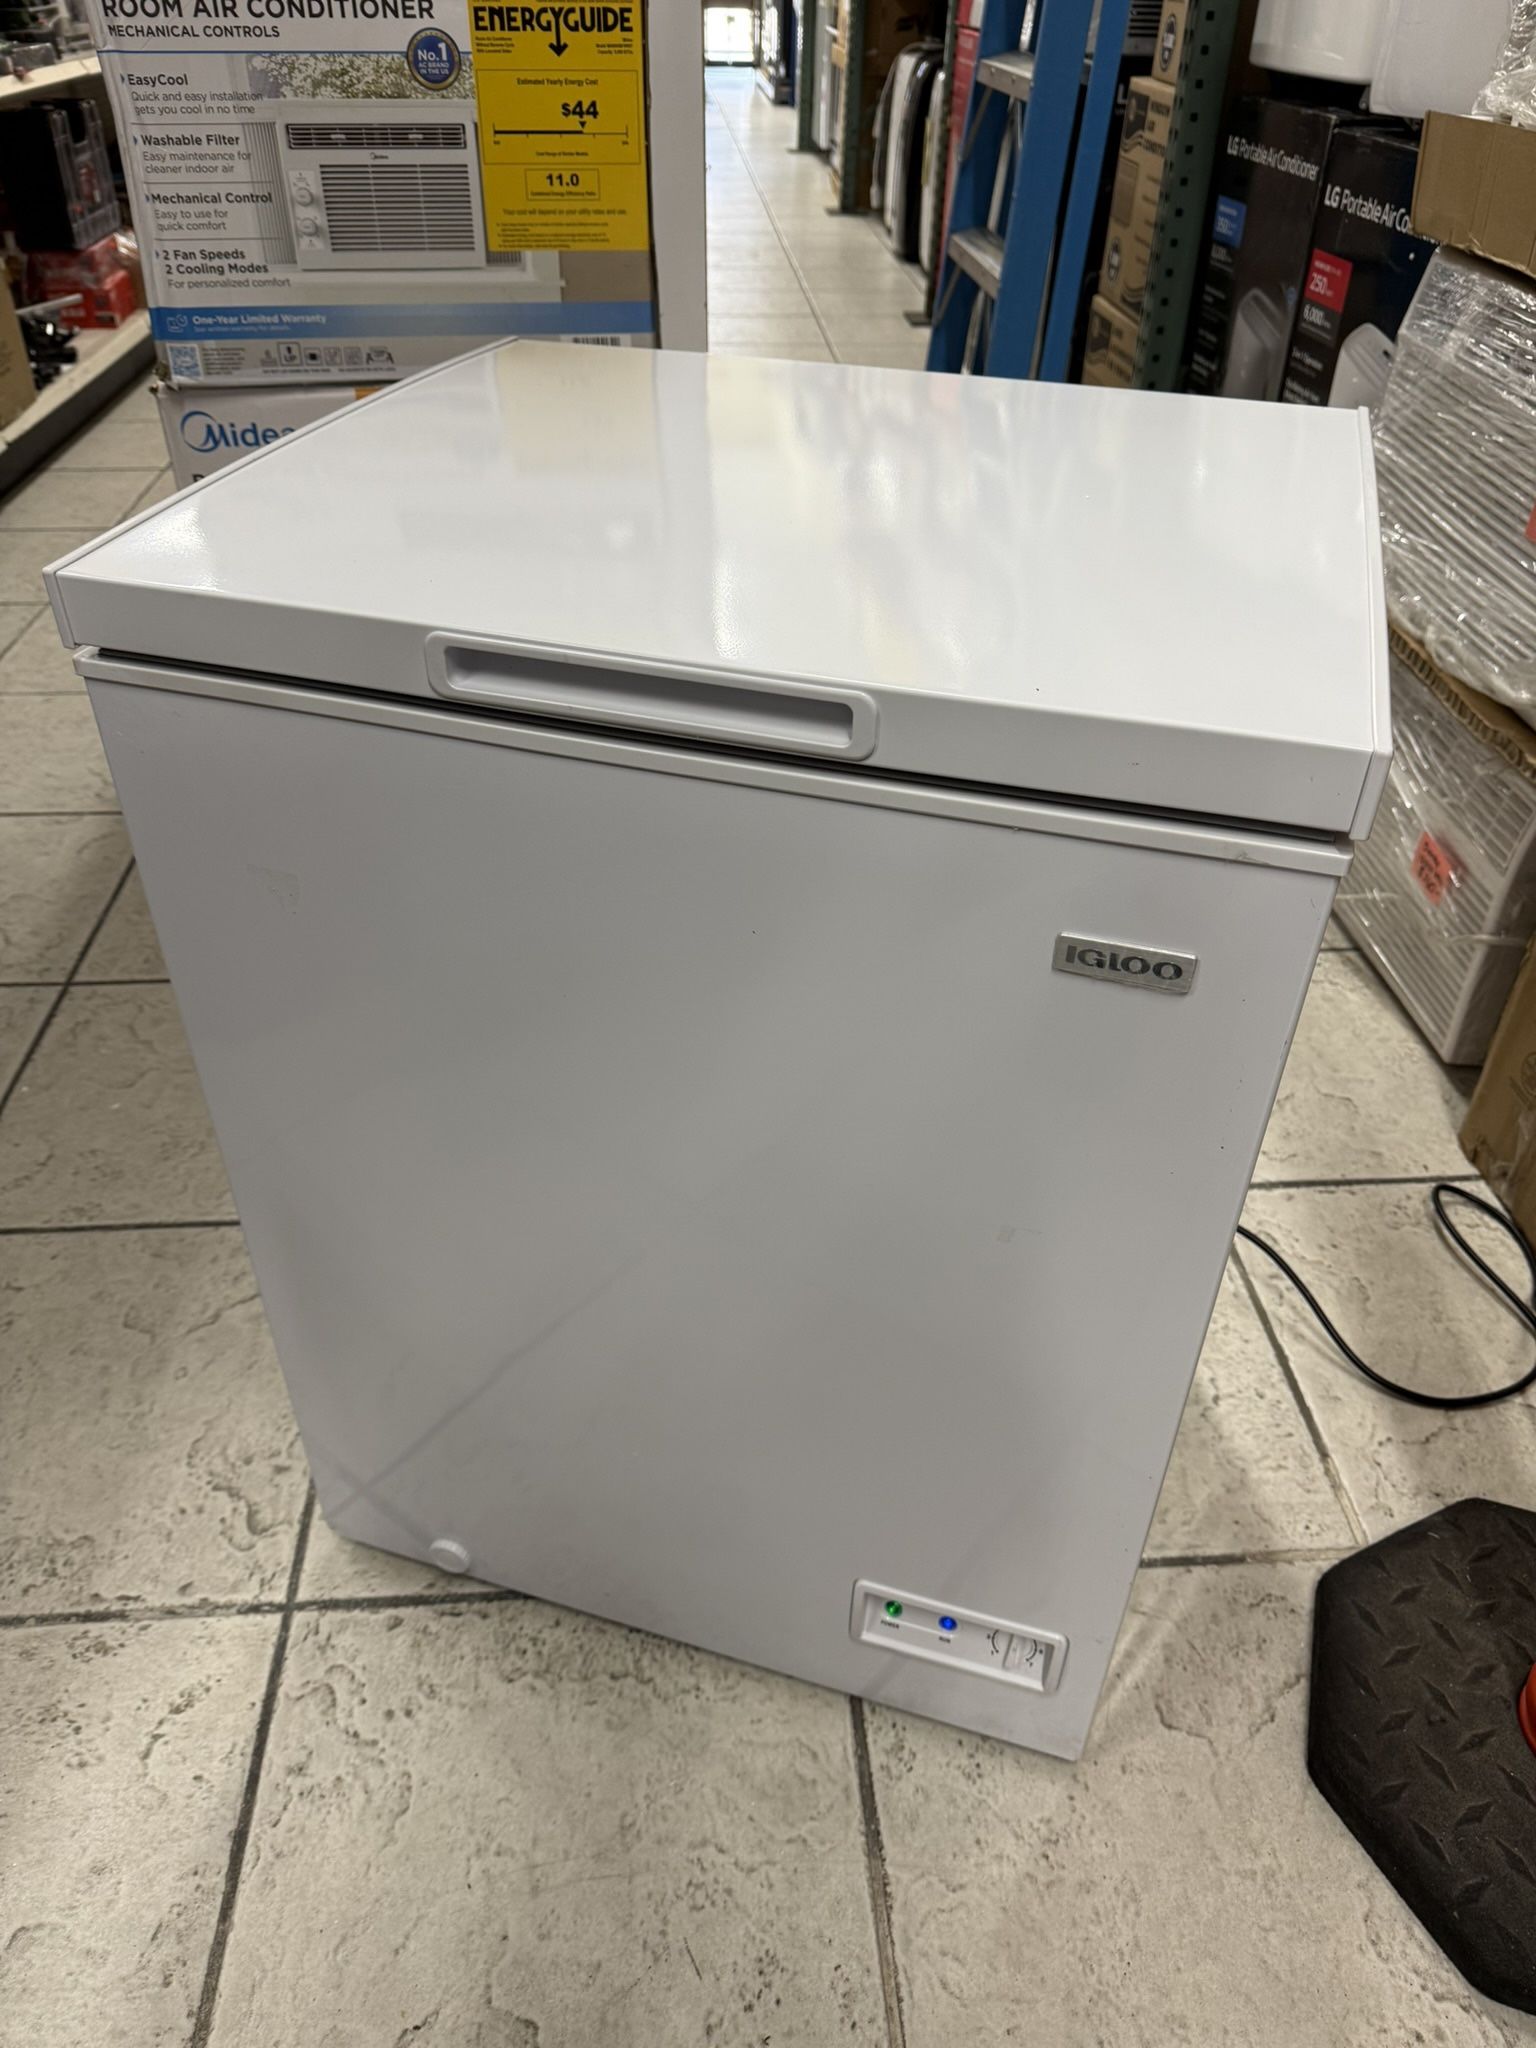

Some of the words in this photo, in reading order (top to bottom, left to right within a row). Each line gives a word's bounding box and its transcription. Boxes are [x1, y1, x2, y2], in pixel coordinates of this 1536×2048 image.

[102, 0, 183, 18] ROOM
[193, 0, 239, 18] AIR
[247, 0, 435, 19] CONDITIONER
[473, 6, 634, 33] ENERGYGUIDE
[108, 24, 200, 38] MECHANICAL
[203, 25, 281, 38] CONTROLS
[417, 41, 448, 61] No.1
[127, 73, 189, 88] EasyCool
[516, 77, 545, 86] Estimated
[545, 77, 563, 87] Yearly
[564, 77, 584, 87] Energy
[585, 78, 599, 86] Cost
[131, 91, 159, 102] Quick
[162, 91, 182, 102] and
[184, 92, 207, 103] easy
[209, 91, 263, 102] installation
[135, 105, 155, 117] gets
[158, 106, 178, 116] you
[180, 105, 201, 115] cool
[204, 105, 215, 115] in
[217, 106, 231, 115] no
[233, 104, 255, 115] time
[561, 100, 599, 119] $44
[140, 134, 202, 146] Washable
[206, 134, 240, 146] Filter
[143, 151, 167, 162] Easy
[169, 151, 236, 161] maintenance
[238, 151, 252, 161] for
[1226, 135, 1239, 156] LG
[1238, 138, 1269, 166] Portable
[1266, 147, 1278, 169] Air
[1277, 150, 1320, 181] Conditioner
[145, 164, 183, 174] cleaner
[185, 163, 219, 174] indoor
[221, 163, 235, 174] air
[546, 173, 580, 187] 11.0
[151, 192, 222, 204] Mechanical
[225, 192, 273, 204] Control
[1324, 183, 1341, 208] LG
[1340, 189, 1382, 224] Portable
[1380, 202, 1397, 228] Air
[154, 209, 178, 221] Easy
[180, 210, 192, 219] to
[193, 210, 212, 219] use
[214, 209, 228, 219] for
[157, 221, 184, 233] quick
[186, 221, 227, 231] comfort
[163, 250, 170, 261] 2
[173, 250, 197, 260] Fan
[200, 249, 246, 262] Speeds
[165, 264, 173, 275] 2
[176, 264, 225, 276] Cooling
[228, 263, 269, 274] Modes
[168, 279, 185, 289] For
[187, 278, 251, 290] personalized
[251, 277, 291, 288] comfort
[192, 315, 239, 325] One-Year
[240, 314, 279, 324] Limited
[280, 314, 327, 326] Warranty
[1065, 944, 1184, 981] IGLOO
